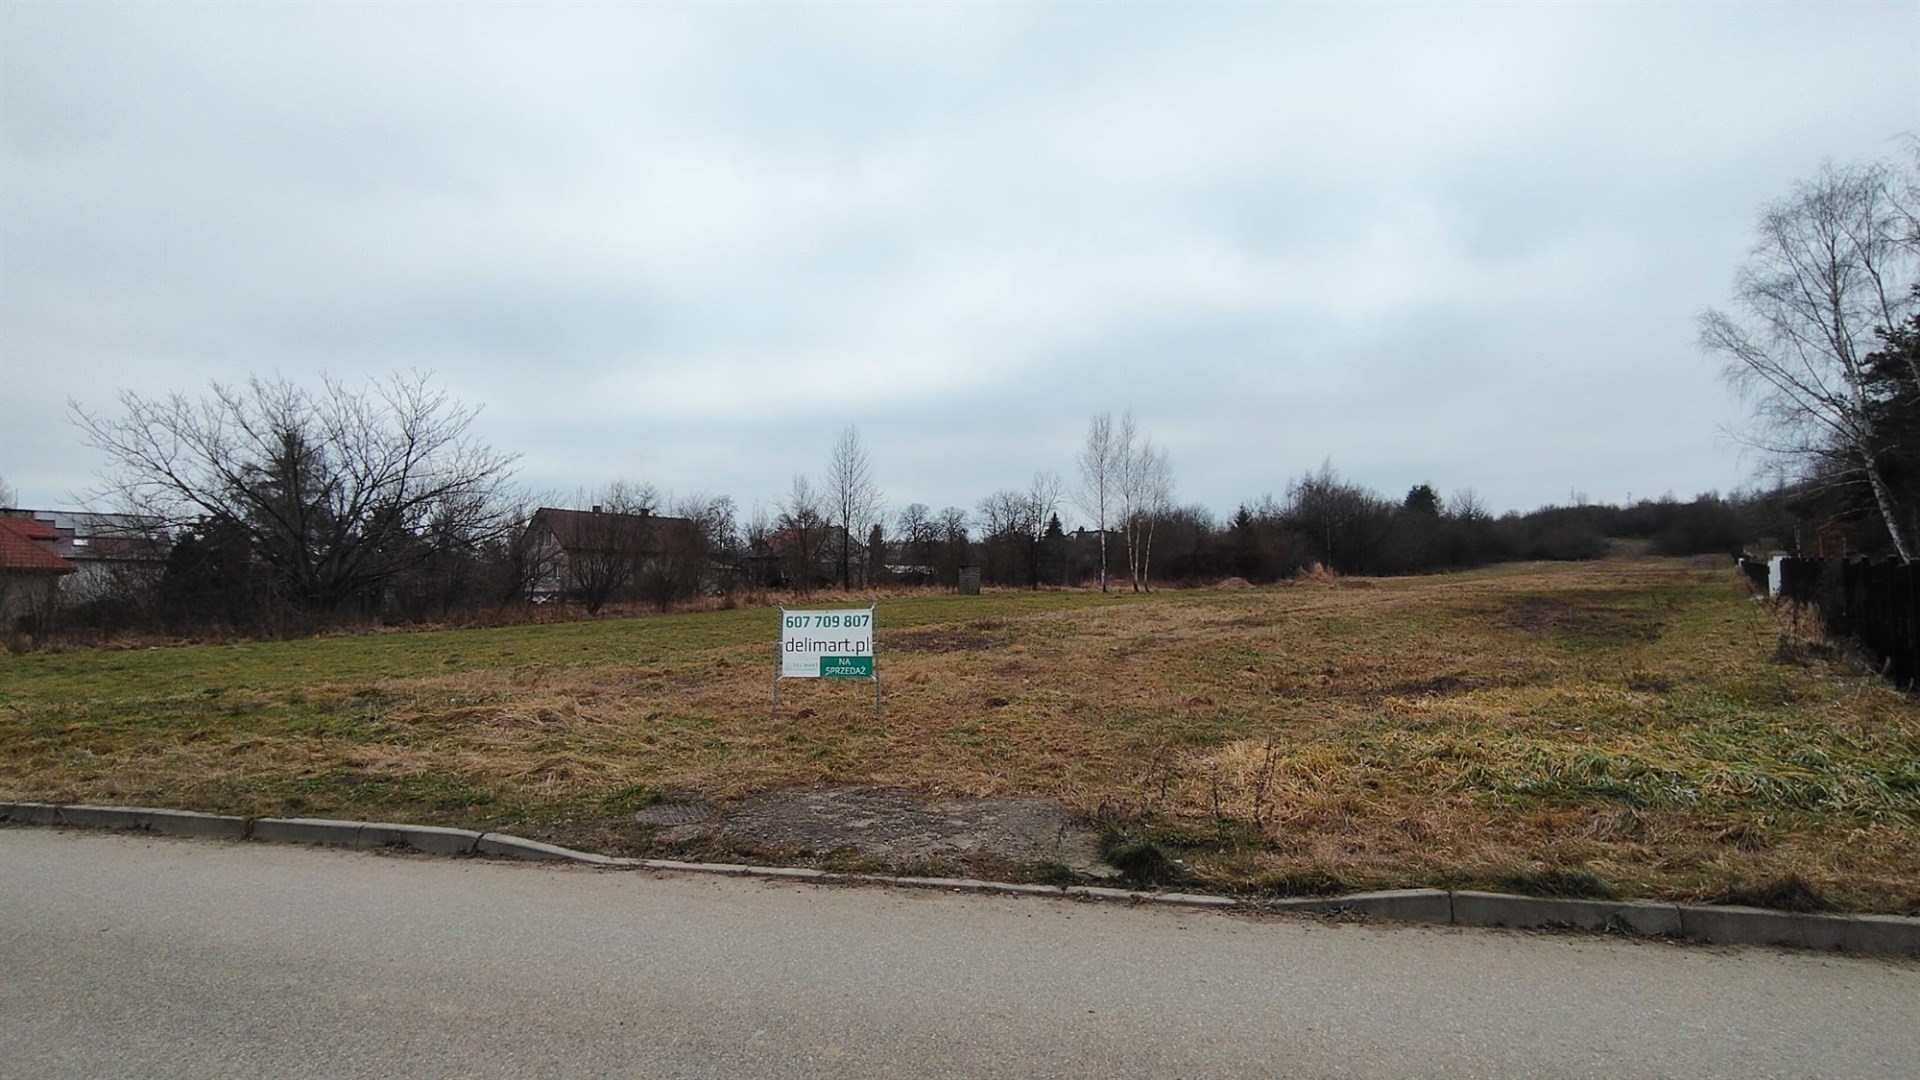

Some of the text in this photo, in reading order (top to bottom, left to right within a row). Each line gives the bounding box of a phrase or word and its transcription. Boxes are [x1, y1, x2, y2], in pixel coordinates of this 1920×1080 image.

[786, 615, 870, 628] 607 709 807
[785, 637, 869, 655] delimart.pl
